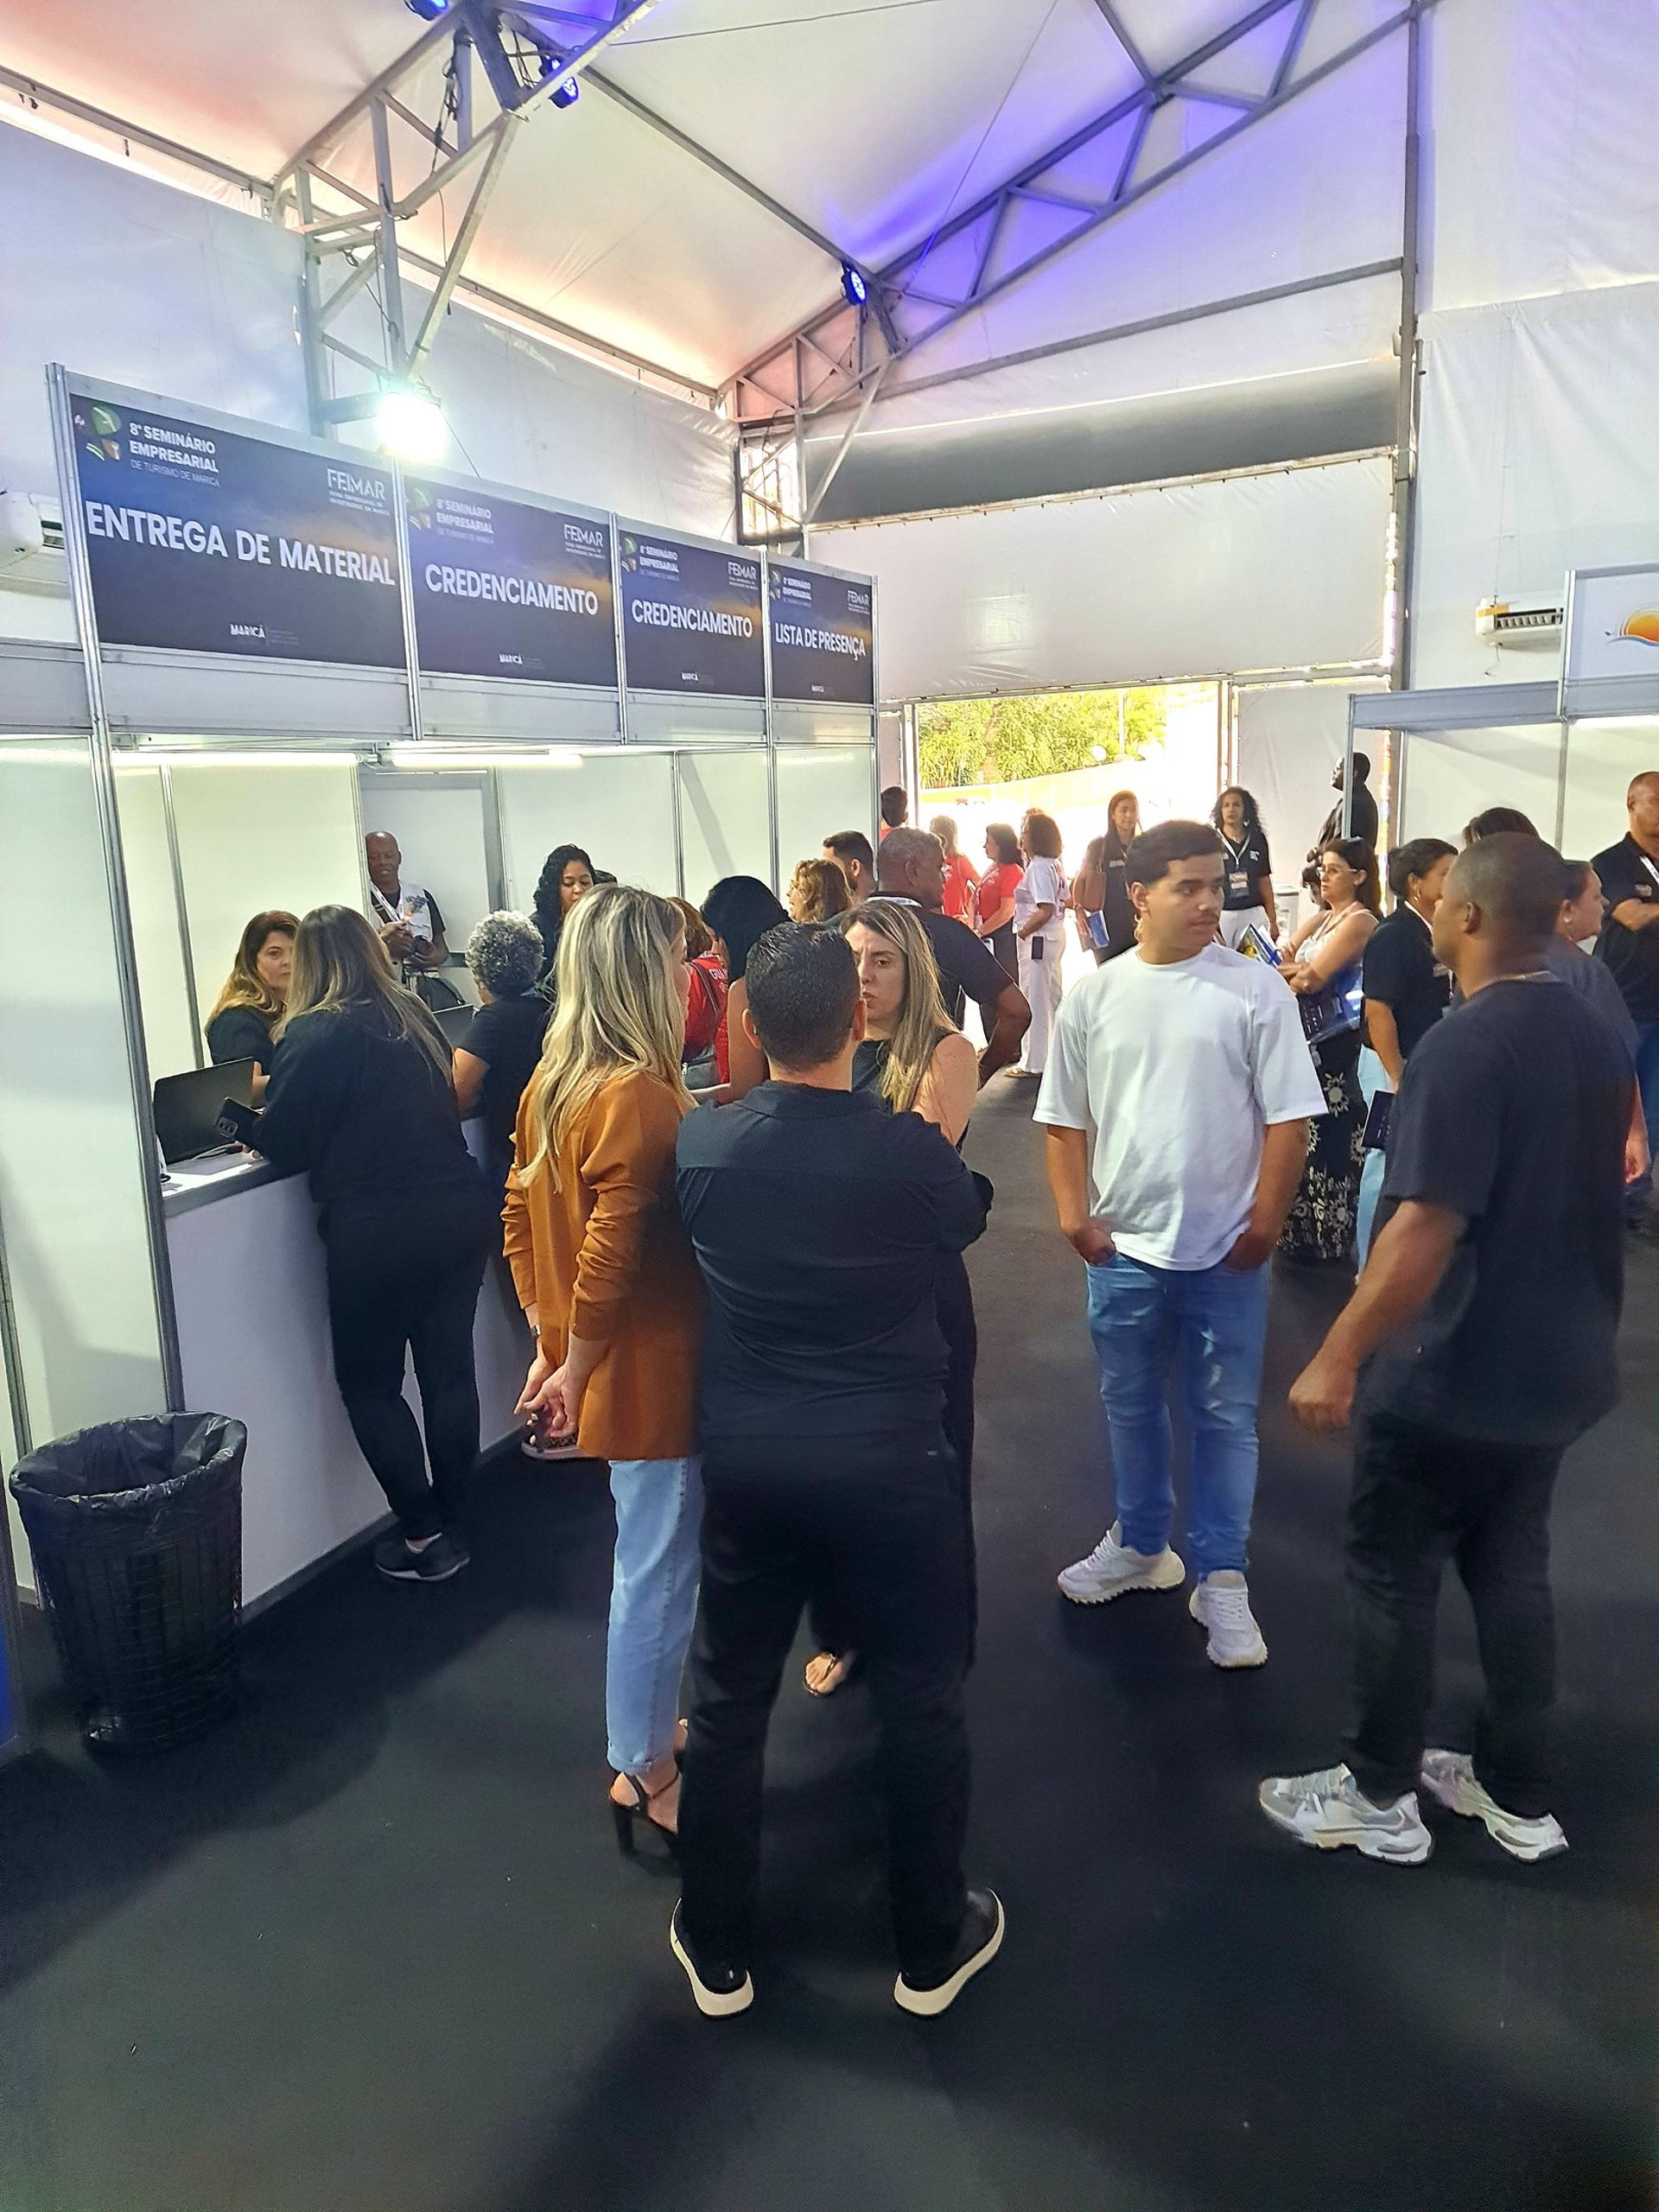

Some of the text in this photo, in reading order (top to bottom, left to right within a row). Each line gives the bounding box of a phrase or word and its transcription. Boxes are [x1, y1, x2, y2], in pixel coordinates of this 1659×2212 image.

[129, 440, 219, 473] EMPRESARIAL
[143, 425, 216, 454] SEMINÁRIO
[436, 512, 494, 533] EMPRESARIAL
[445, 499, 492, 519] SEMINÁRIO
[86, 500, 396, 586] ENTREGA DE MATERIAL
[425, 563, 599, 615] CREDENCIAMENTO
[632, 599, 753, 638] CREDENCIAMENTO
[775, 622, 867, 661] LISTA DE PRESENÇA
